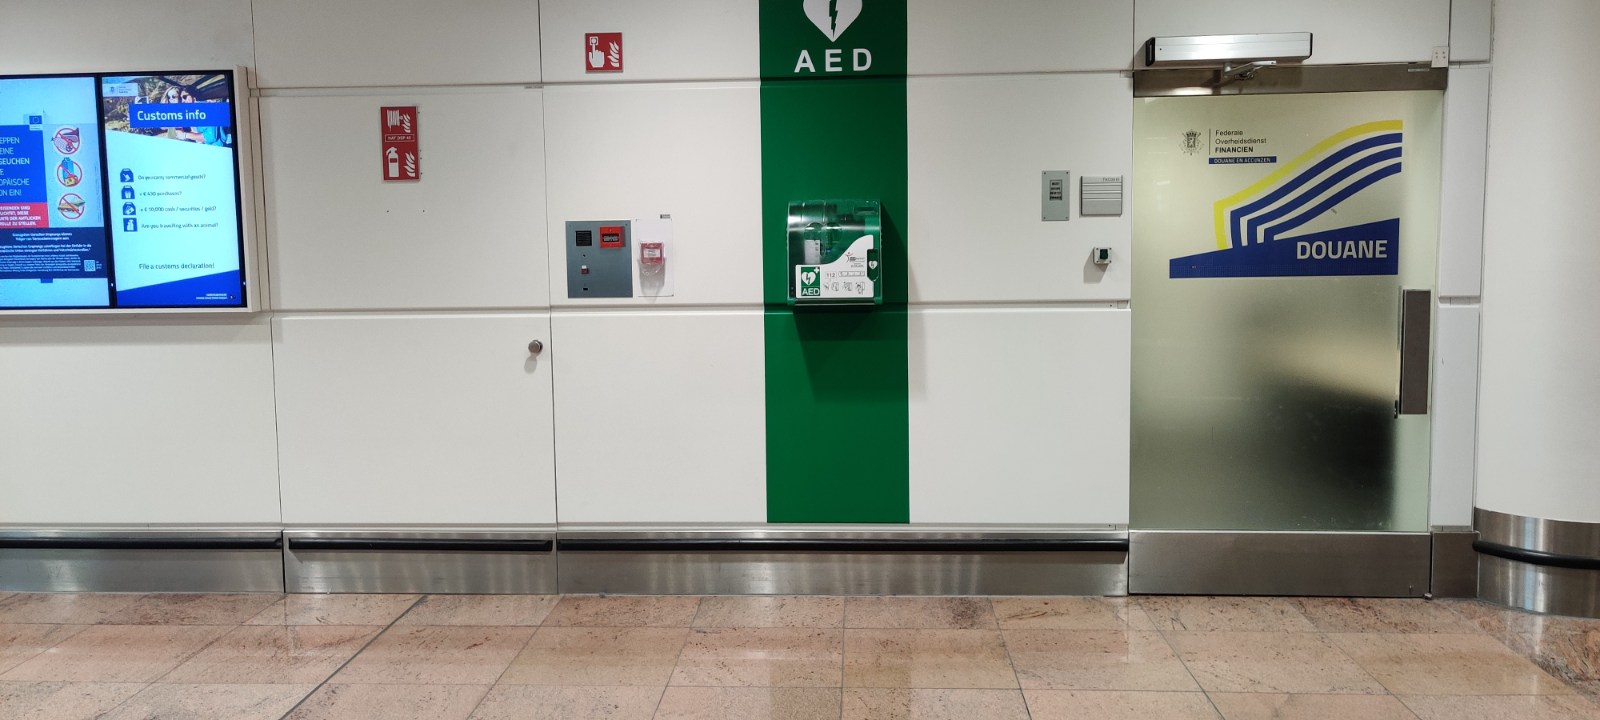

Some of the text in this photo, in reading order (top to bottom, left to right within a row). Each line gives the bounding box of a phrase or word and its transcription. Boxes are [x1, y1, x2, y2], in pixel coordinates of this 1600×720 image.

[794, 48, 872, 73] AED
[137, 109, 207, 121] Customs info
[1296, 240, 1388, 260] DOUANE
[802, 288, 820, 296] AED
